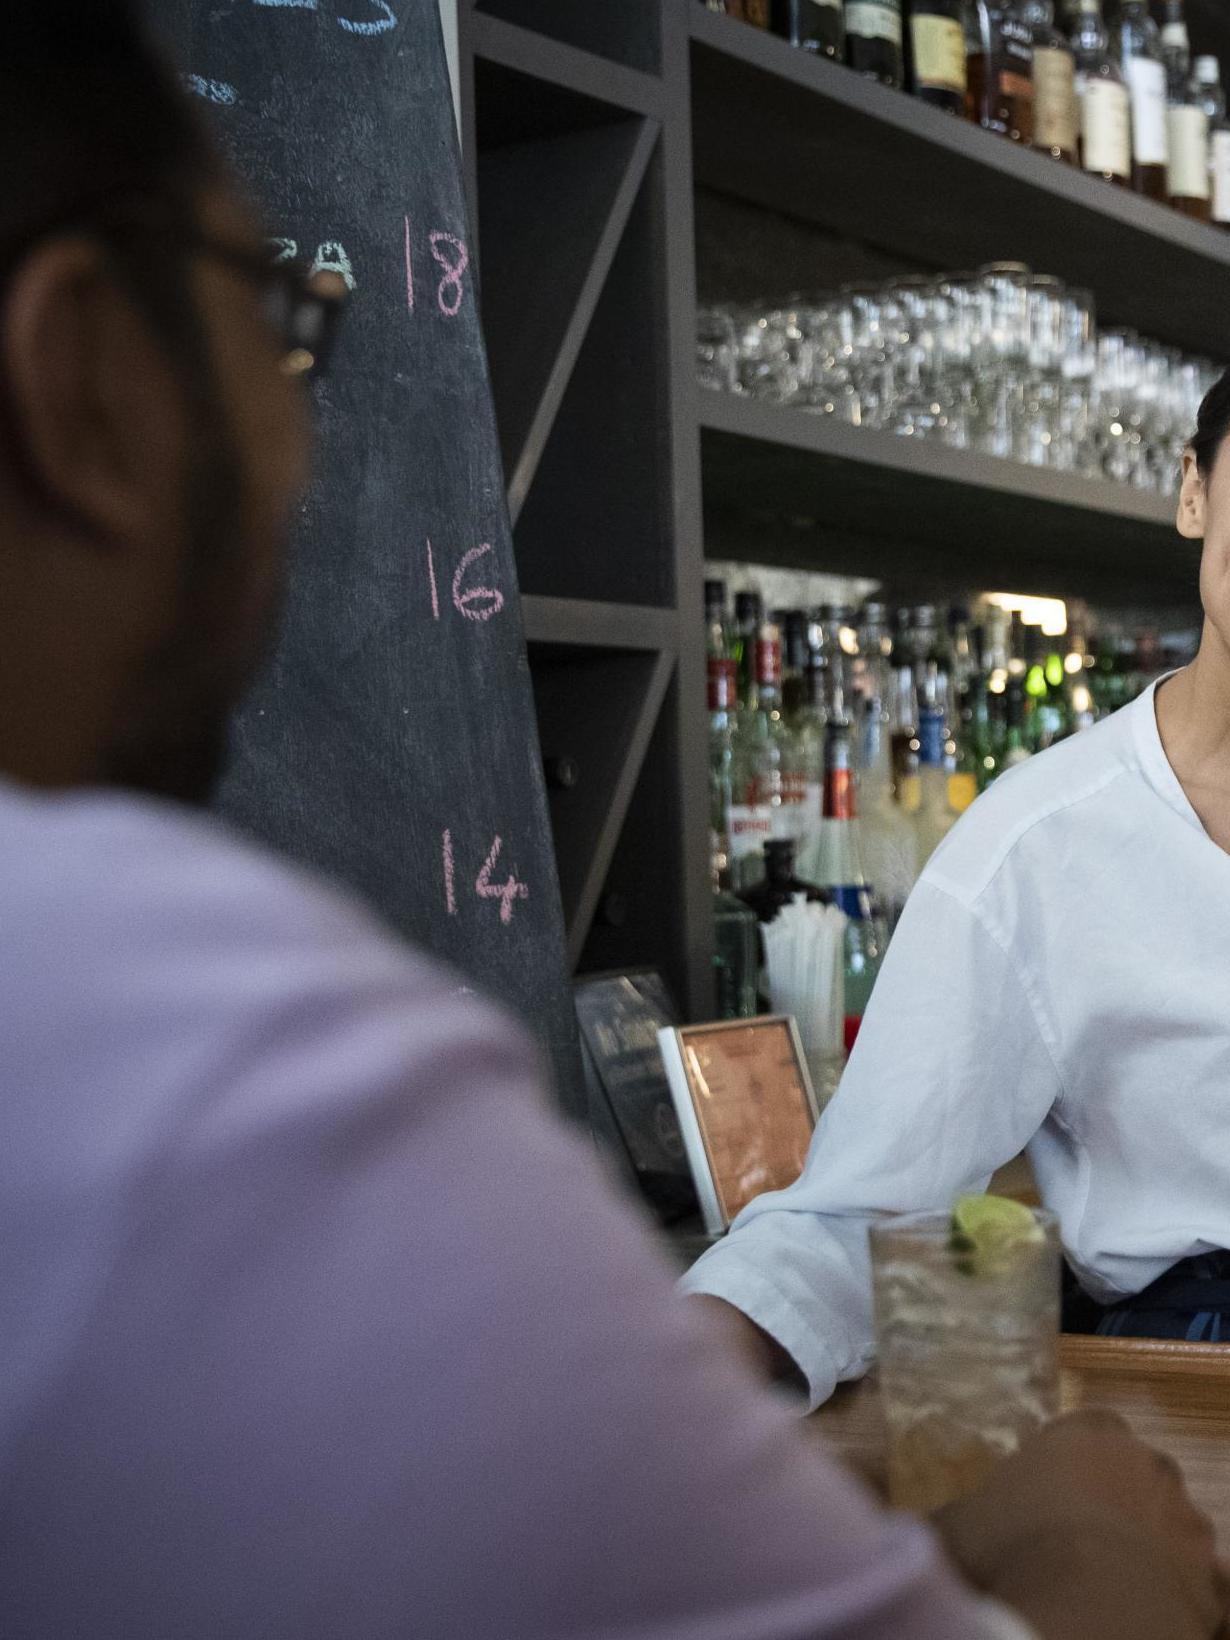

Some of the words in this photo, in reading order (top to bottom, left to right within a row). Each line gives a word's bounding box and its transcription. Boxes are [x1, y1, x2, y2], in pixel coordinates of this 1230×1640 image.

[403, 214, 469, 317] 18
[426, 536, 504, 622] 16
[441, 827, 529, 925] 14
